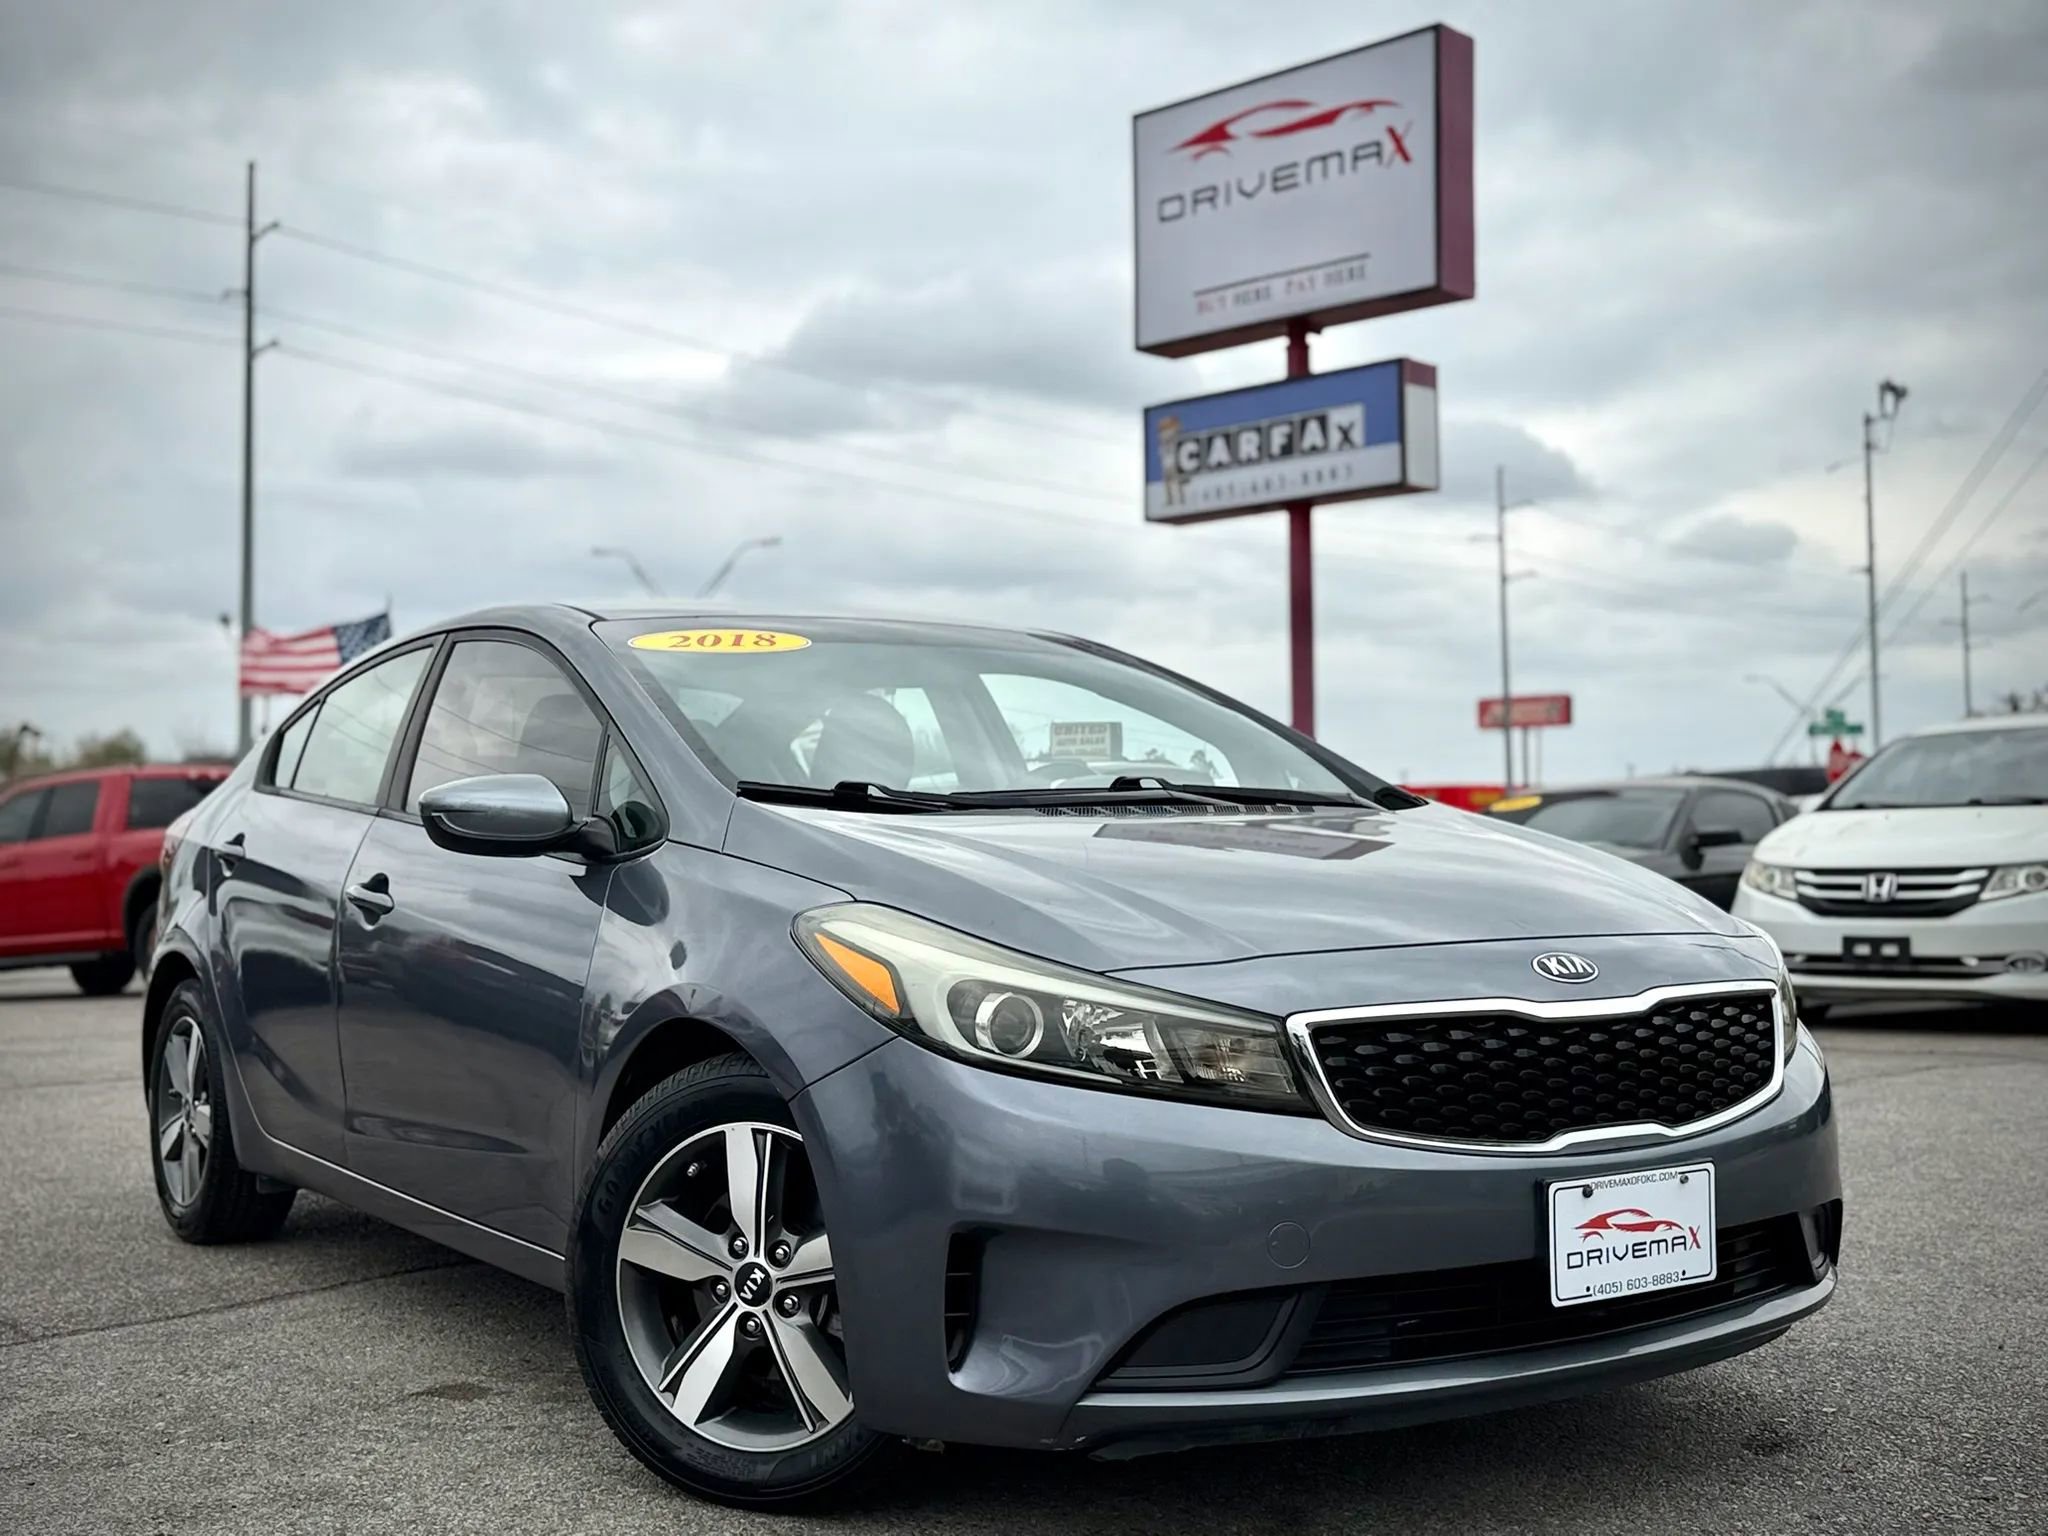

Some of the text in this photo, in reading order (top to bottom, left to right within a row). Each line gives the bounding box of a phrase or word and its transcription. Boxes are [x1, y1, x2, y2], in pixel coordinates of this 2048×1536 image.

[1157, 120, 1414, 224] DRIVEMAX
[1177, 414, 1357, 472] CARFAX
[668, 633, 777, 648] 2018
[1540, 956, 1593, 975] KIA
[1567, 1225, 1701, 1270] DRIVEMAX
[740, 1267, 766, 1300] KIA
[1593, 1271, 1680, 1297] (405) 603-8883
